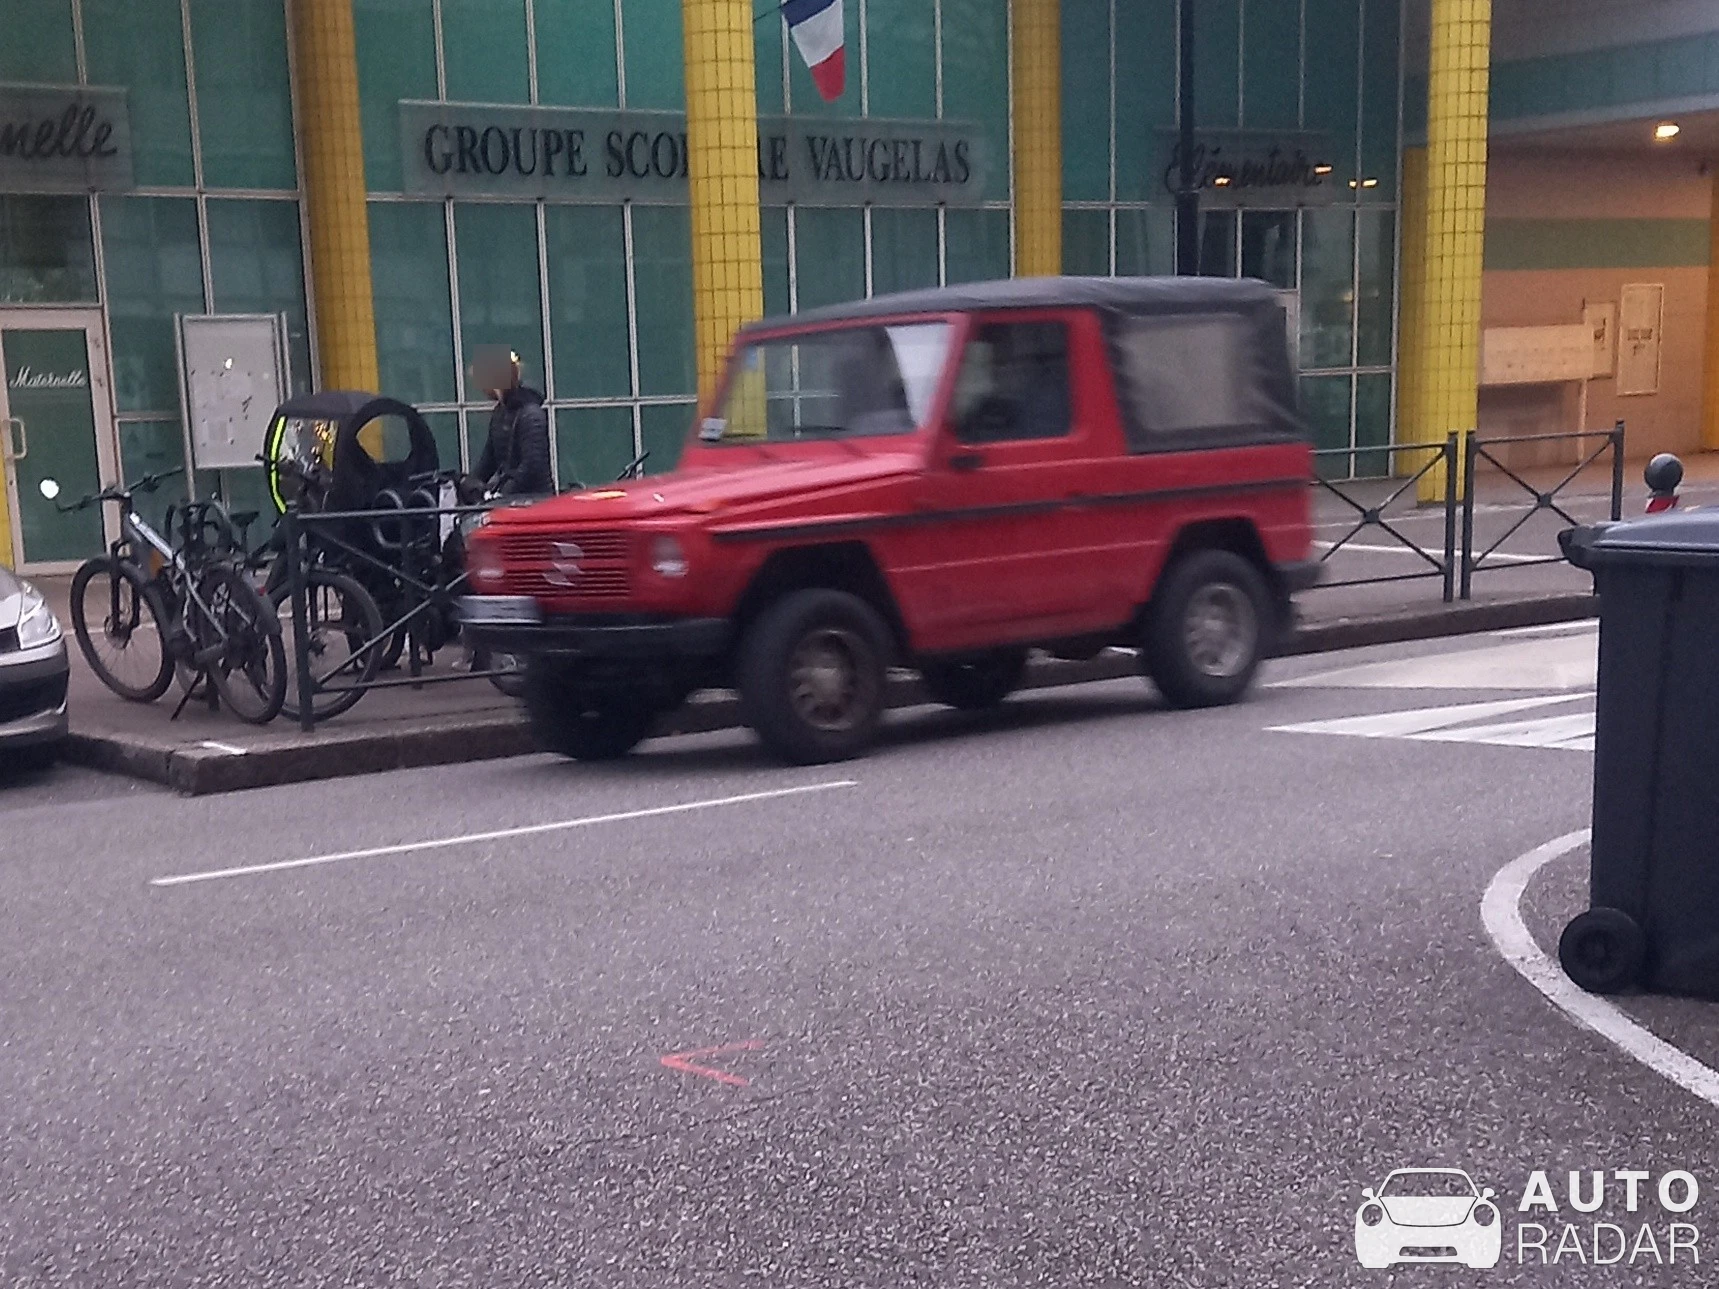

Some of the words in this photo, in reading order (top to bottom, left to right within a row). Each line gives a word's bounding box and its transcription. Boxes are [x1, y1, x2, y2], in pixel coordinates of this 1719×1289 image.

[425, 123, 587, 177] GROUPE
[806, 135, 970, 184] VAUGELAS
[9, 365, 86, 388] Maternelle
